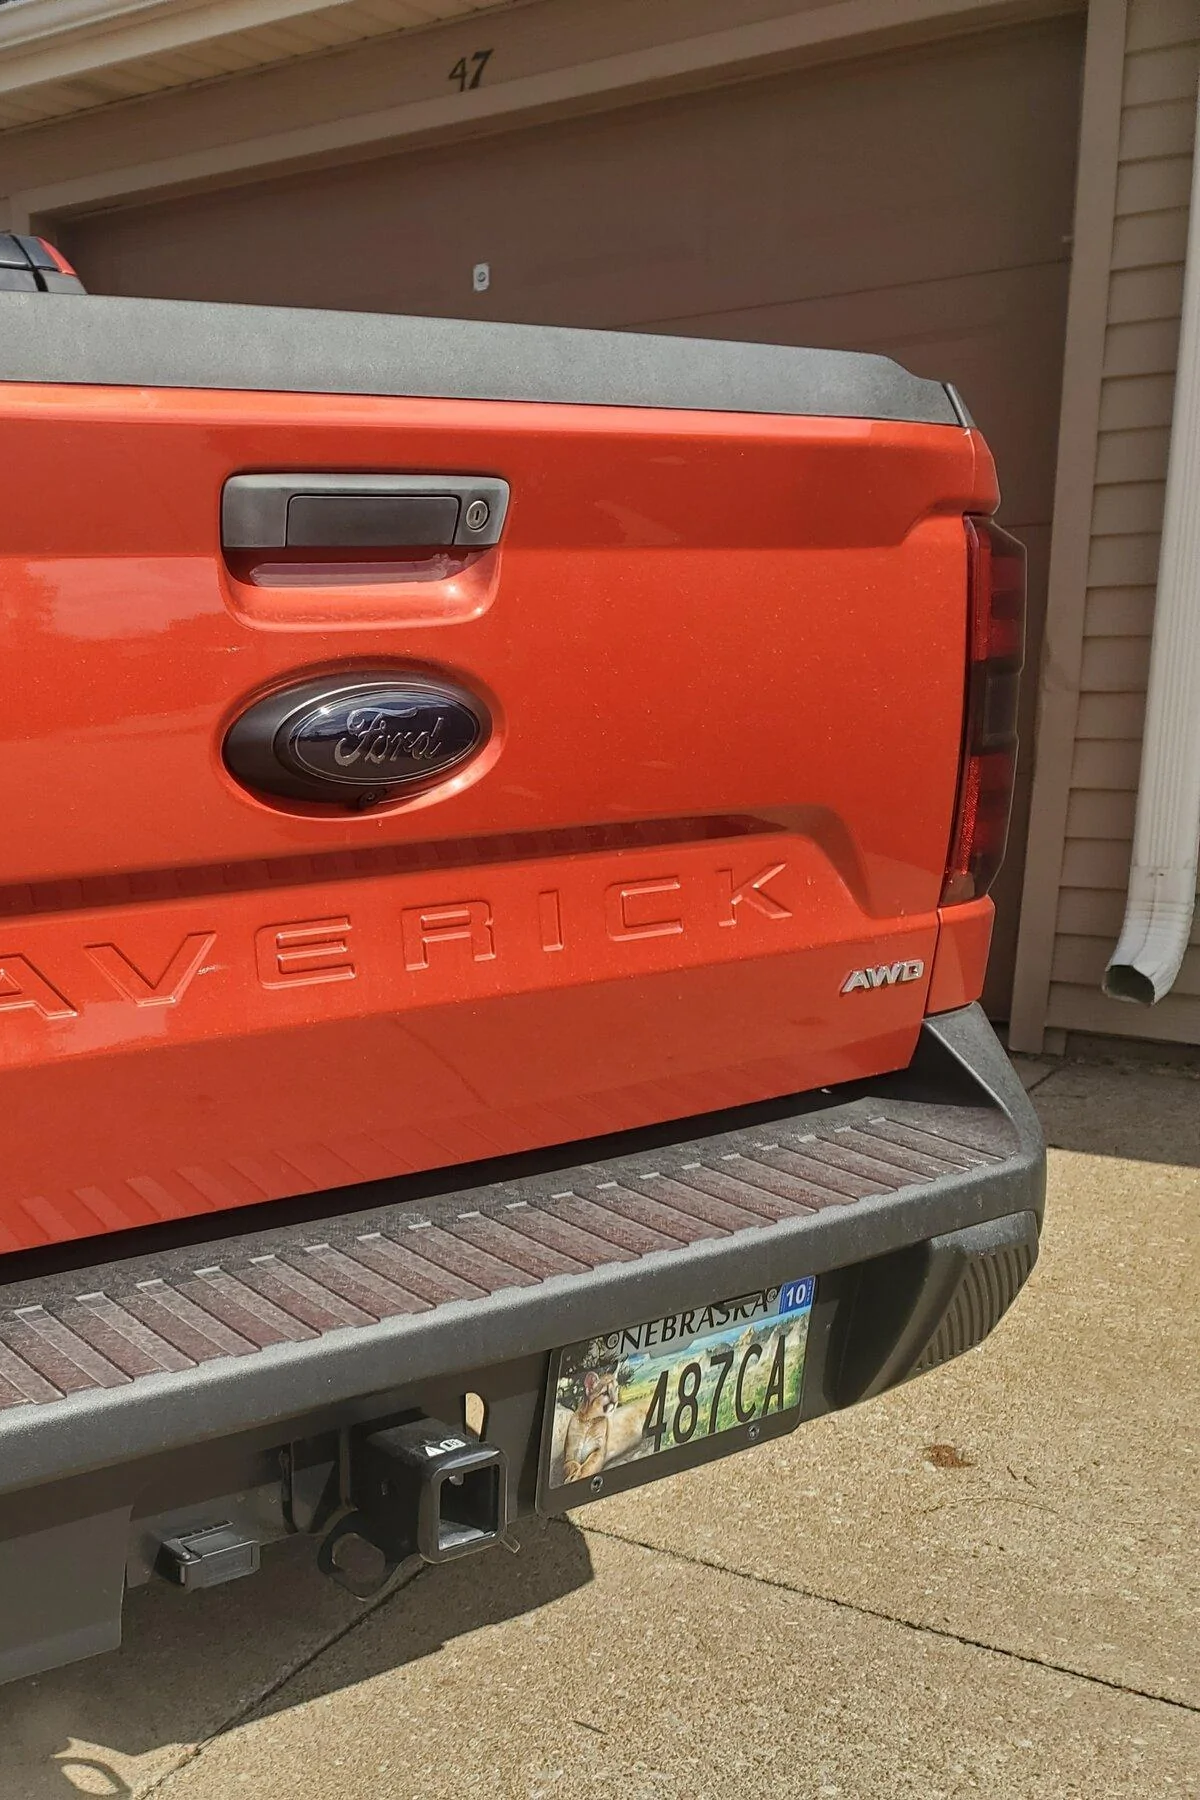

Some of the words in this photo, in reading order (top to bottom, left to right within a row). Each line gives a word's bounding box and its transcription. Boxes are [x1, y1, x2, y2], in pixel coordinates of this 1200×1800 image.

[448, 48, 494, 92] 47
[334, 706, 444, 767] Ford
[840, 959, 925, 994] AWD
[618, 1286, 769, 1355] NEBRASKA
[786, 1283, 807, 1308] 10
[641, 1334, 787, 1452] 487CA
